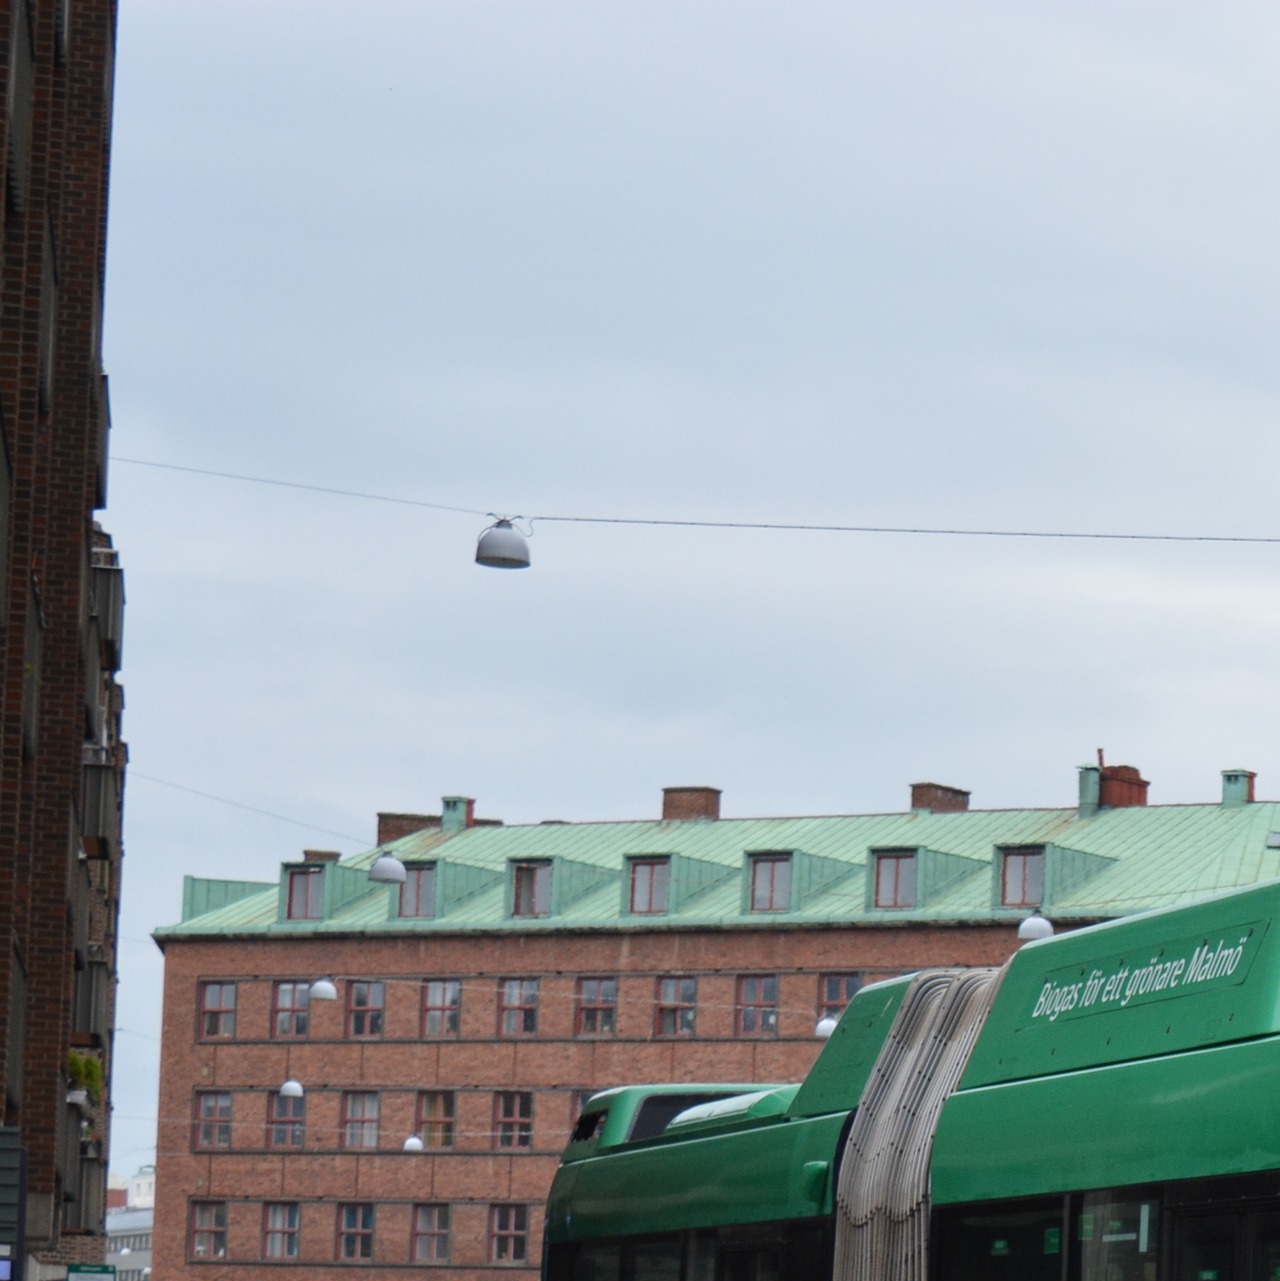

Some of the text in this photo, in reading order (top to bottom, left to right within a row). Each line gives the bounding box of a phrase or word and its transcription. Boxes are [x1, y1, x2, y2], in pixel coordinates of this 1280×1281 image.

[1031, 937, 1248, 1022] Biogas för ett grönare Malmö
